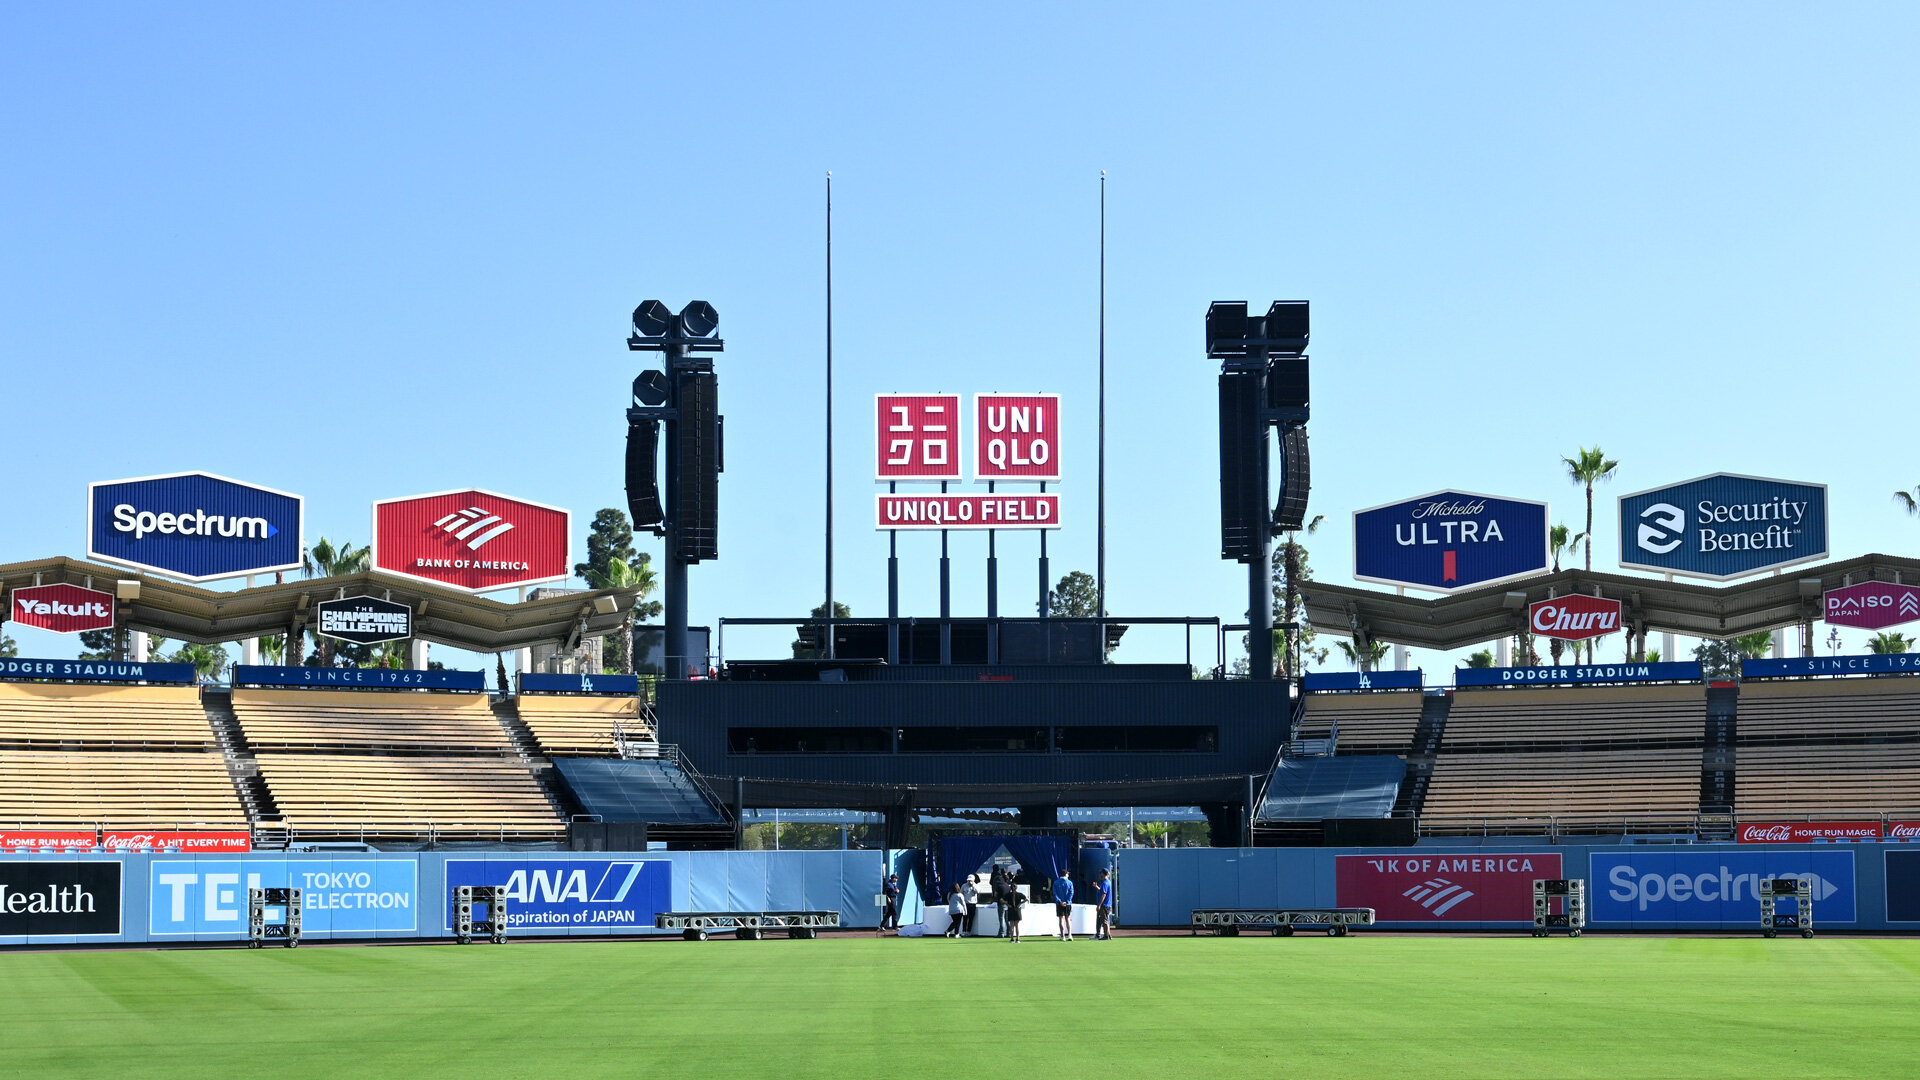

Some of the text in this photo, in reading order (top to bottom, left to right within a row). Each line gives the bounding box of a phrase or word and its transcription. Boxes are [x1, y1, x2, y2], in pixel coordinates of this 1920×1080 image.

[889, 406, 947, 432] ユニ
[987, 406, 1043, 433] UNI
[887, 439, 947, 465] クロ
[988, 438, 1049, 470] QLO
[887, 500, 1050, 524] UNIQLO FIELD
[1412, 500, 1487, 518] Michelob
[1698, 496, 1808, 525] Security
[113, 504, 268, 539] Spectrum
[1396, 519, 1504, 546] ULTRA
[1699, 524, 1794, 552] Benefit
[417, 558, 529, 571] BANK OF AMERICA
[17, 599, 109, 618] Yakult
[1828, 595, 1893, 609] DAISO
[321, 610, 408, 623] CHAMPIONS
[1533, 606, 1617, 631] Churu
[321, 621, 408, 634] COLLECTIVE
[64, 664, 143, 676] STADIUM
[1808, 659, 1870, 670] SINCE
[304, 671, 423, 683] SINCE 1962
[581, 672, 593, 691] LA
[1359, 671, 1371, 689] LA
[1502, 666, 1649, 681] DODGER STADIUM
[1744, 825, 1792, 840] Coca-Cola
[1794, 829, 1823, 837] HOME
[6, 838, 36, 846] HOME
[38, 838, 58, 846] RUN
[60, 838, 92, 846] MAGIC
[104, 835, 155, 848] Coca-Cola
[167, 839, 185, 847] HIT
[186, 839, 220, 847] EVERY
[1405, 859, 1432, 873] OF
[1437, 858, 1533, 873] AMERICA
[302, 872, 371, 888] TOKYO
[505, 869, 588, 903] ANA
[305, 892, 409, 909] ELECTRON
[574, 910, 588, 922] of
[590, 910, 635, 922] JAPAN
